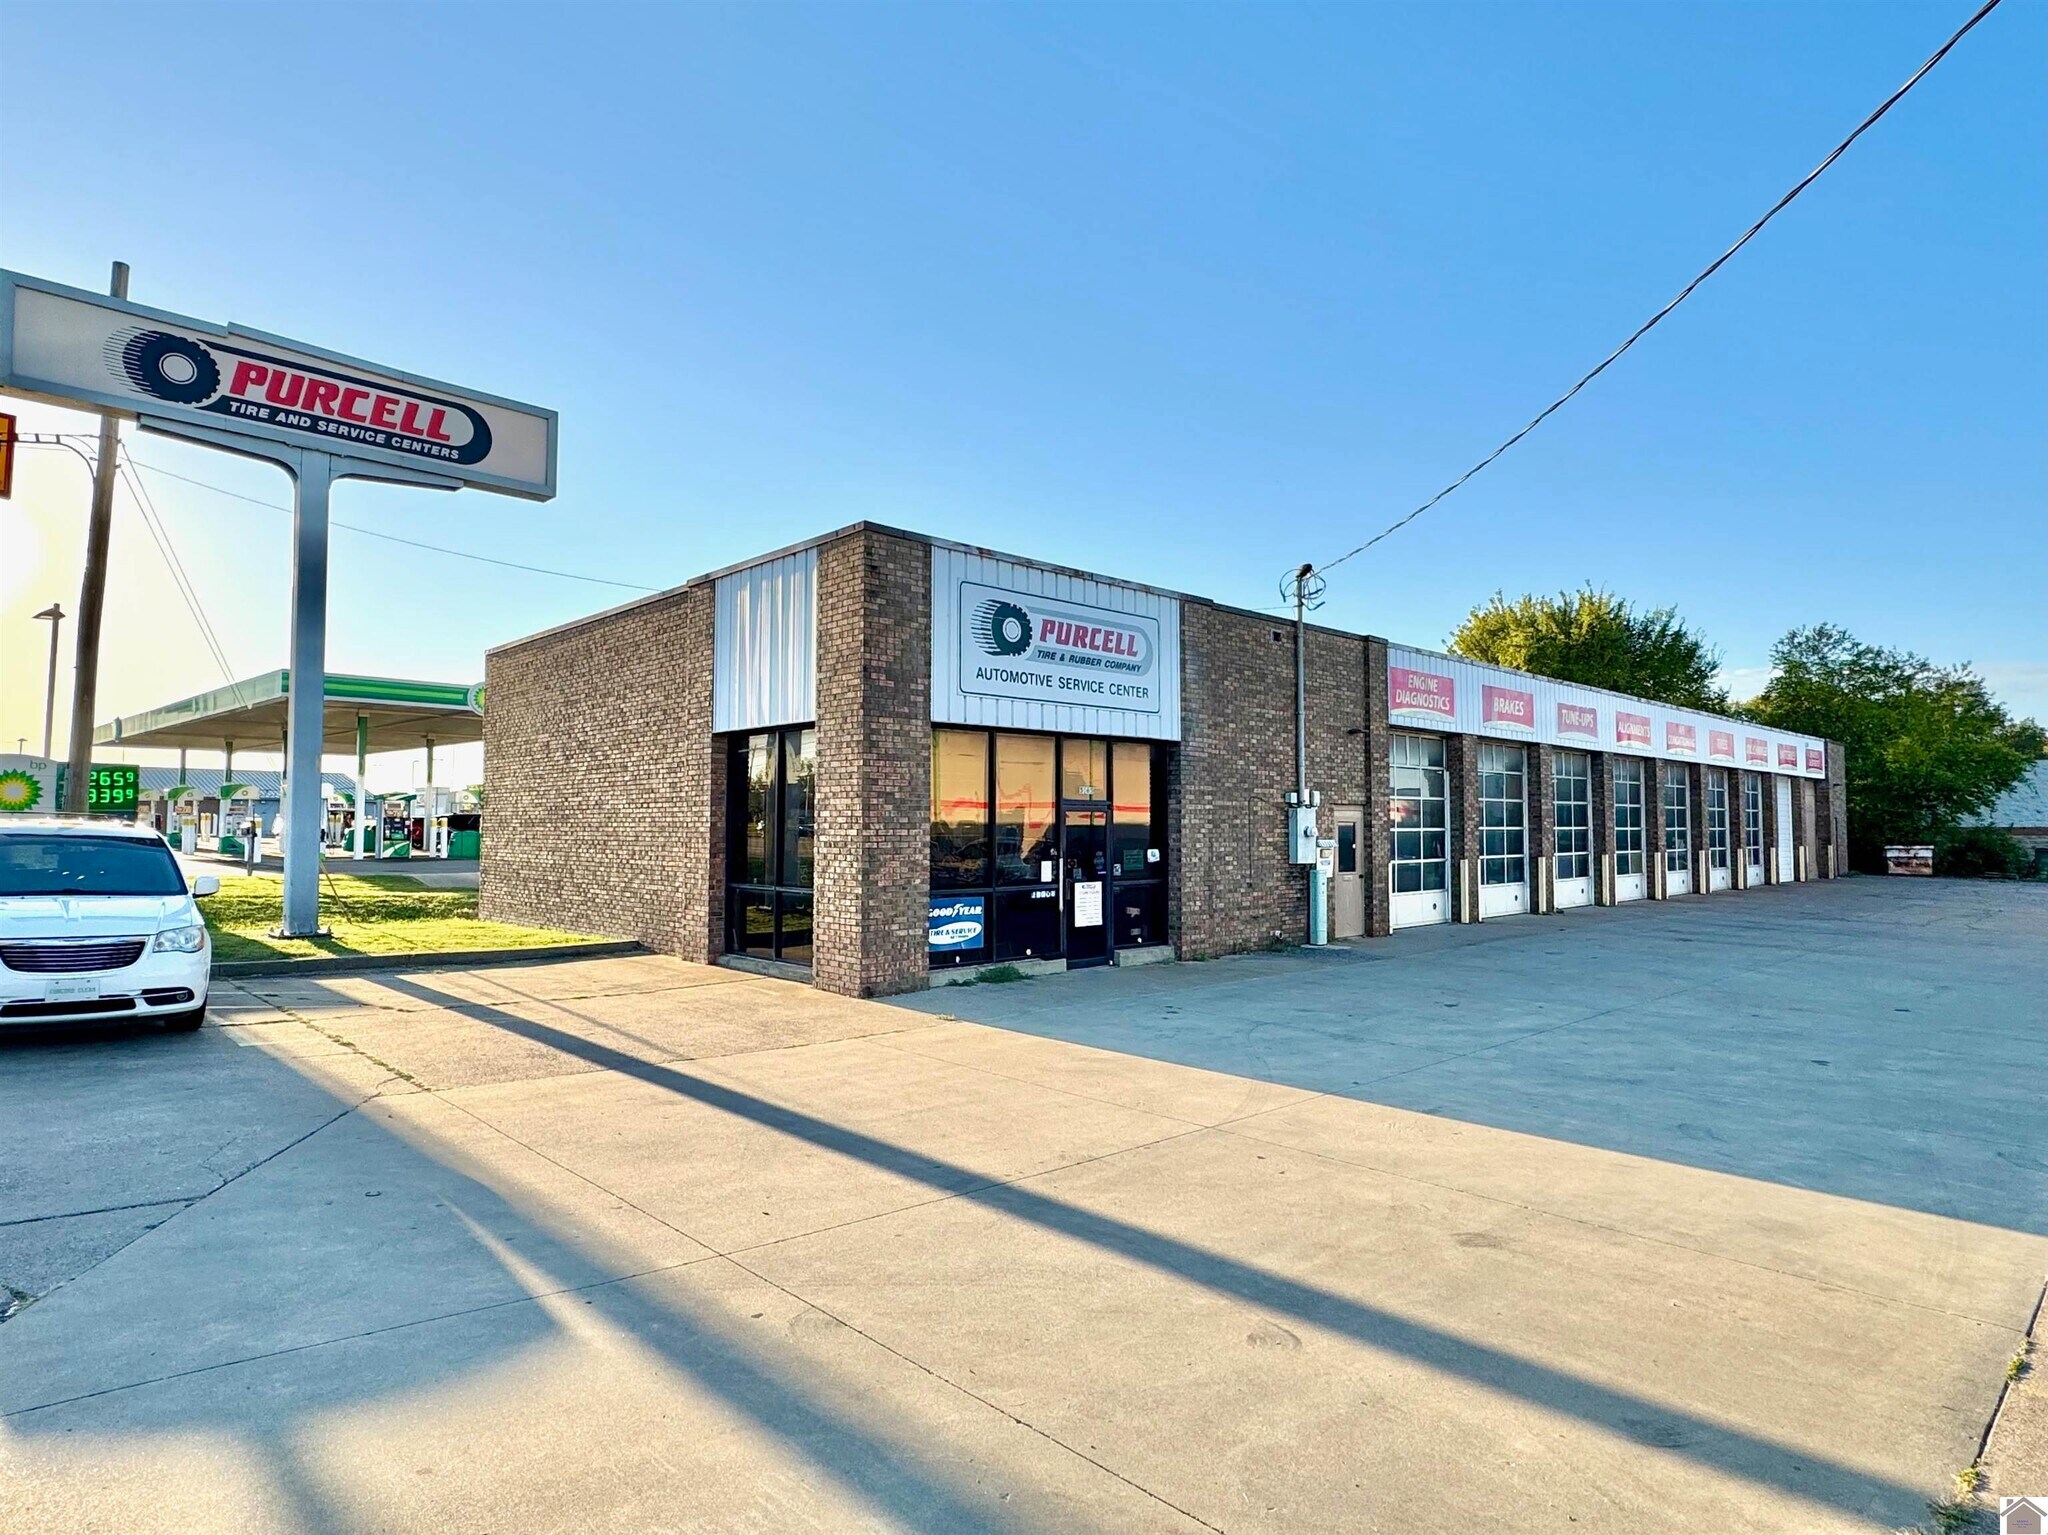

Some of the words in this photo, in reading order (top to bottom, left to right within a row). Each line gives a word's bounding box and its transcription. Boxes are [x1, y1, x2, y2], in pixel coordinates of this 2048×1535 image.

[228, 360, 452, 442] PURCELL
[229, 401, 270, 419] TIRE
[275, 411, 311, 428] AND
[316, 421, 386, 444] SERVICE
[391, 436, 460, 460] CENTERS
[1039, 618, 1139, 658] PURCELL
[1037, 650, 1056, 661] TIRE
[1059, 653, 1065, 662] &
[1068, 655, 1102, 667] RUBBER
[1105, 659, 1142, 673] COMPANY
[976, 666, 1053, 688] AUTOMOTIVE
[1058, 677, 1105, 694] SERVICE
[1109, 683, 1149, 699] CENTER
[1408, 674, 1439, 693] ENGINE
[1395, 689, 1450, 711] DIAGNOSTICS
[1493, 697, 1524, 716] BRAKES
[1561, 709, 1594, 728] TUNE-UPS
[1617, 721, 1650, 738] ALIGNMENTS
[30, 760, 47, 771] bp
